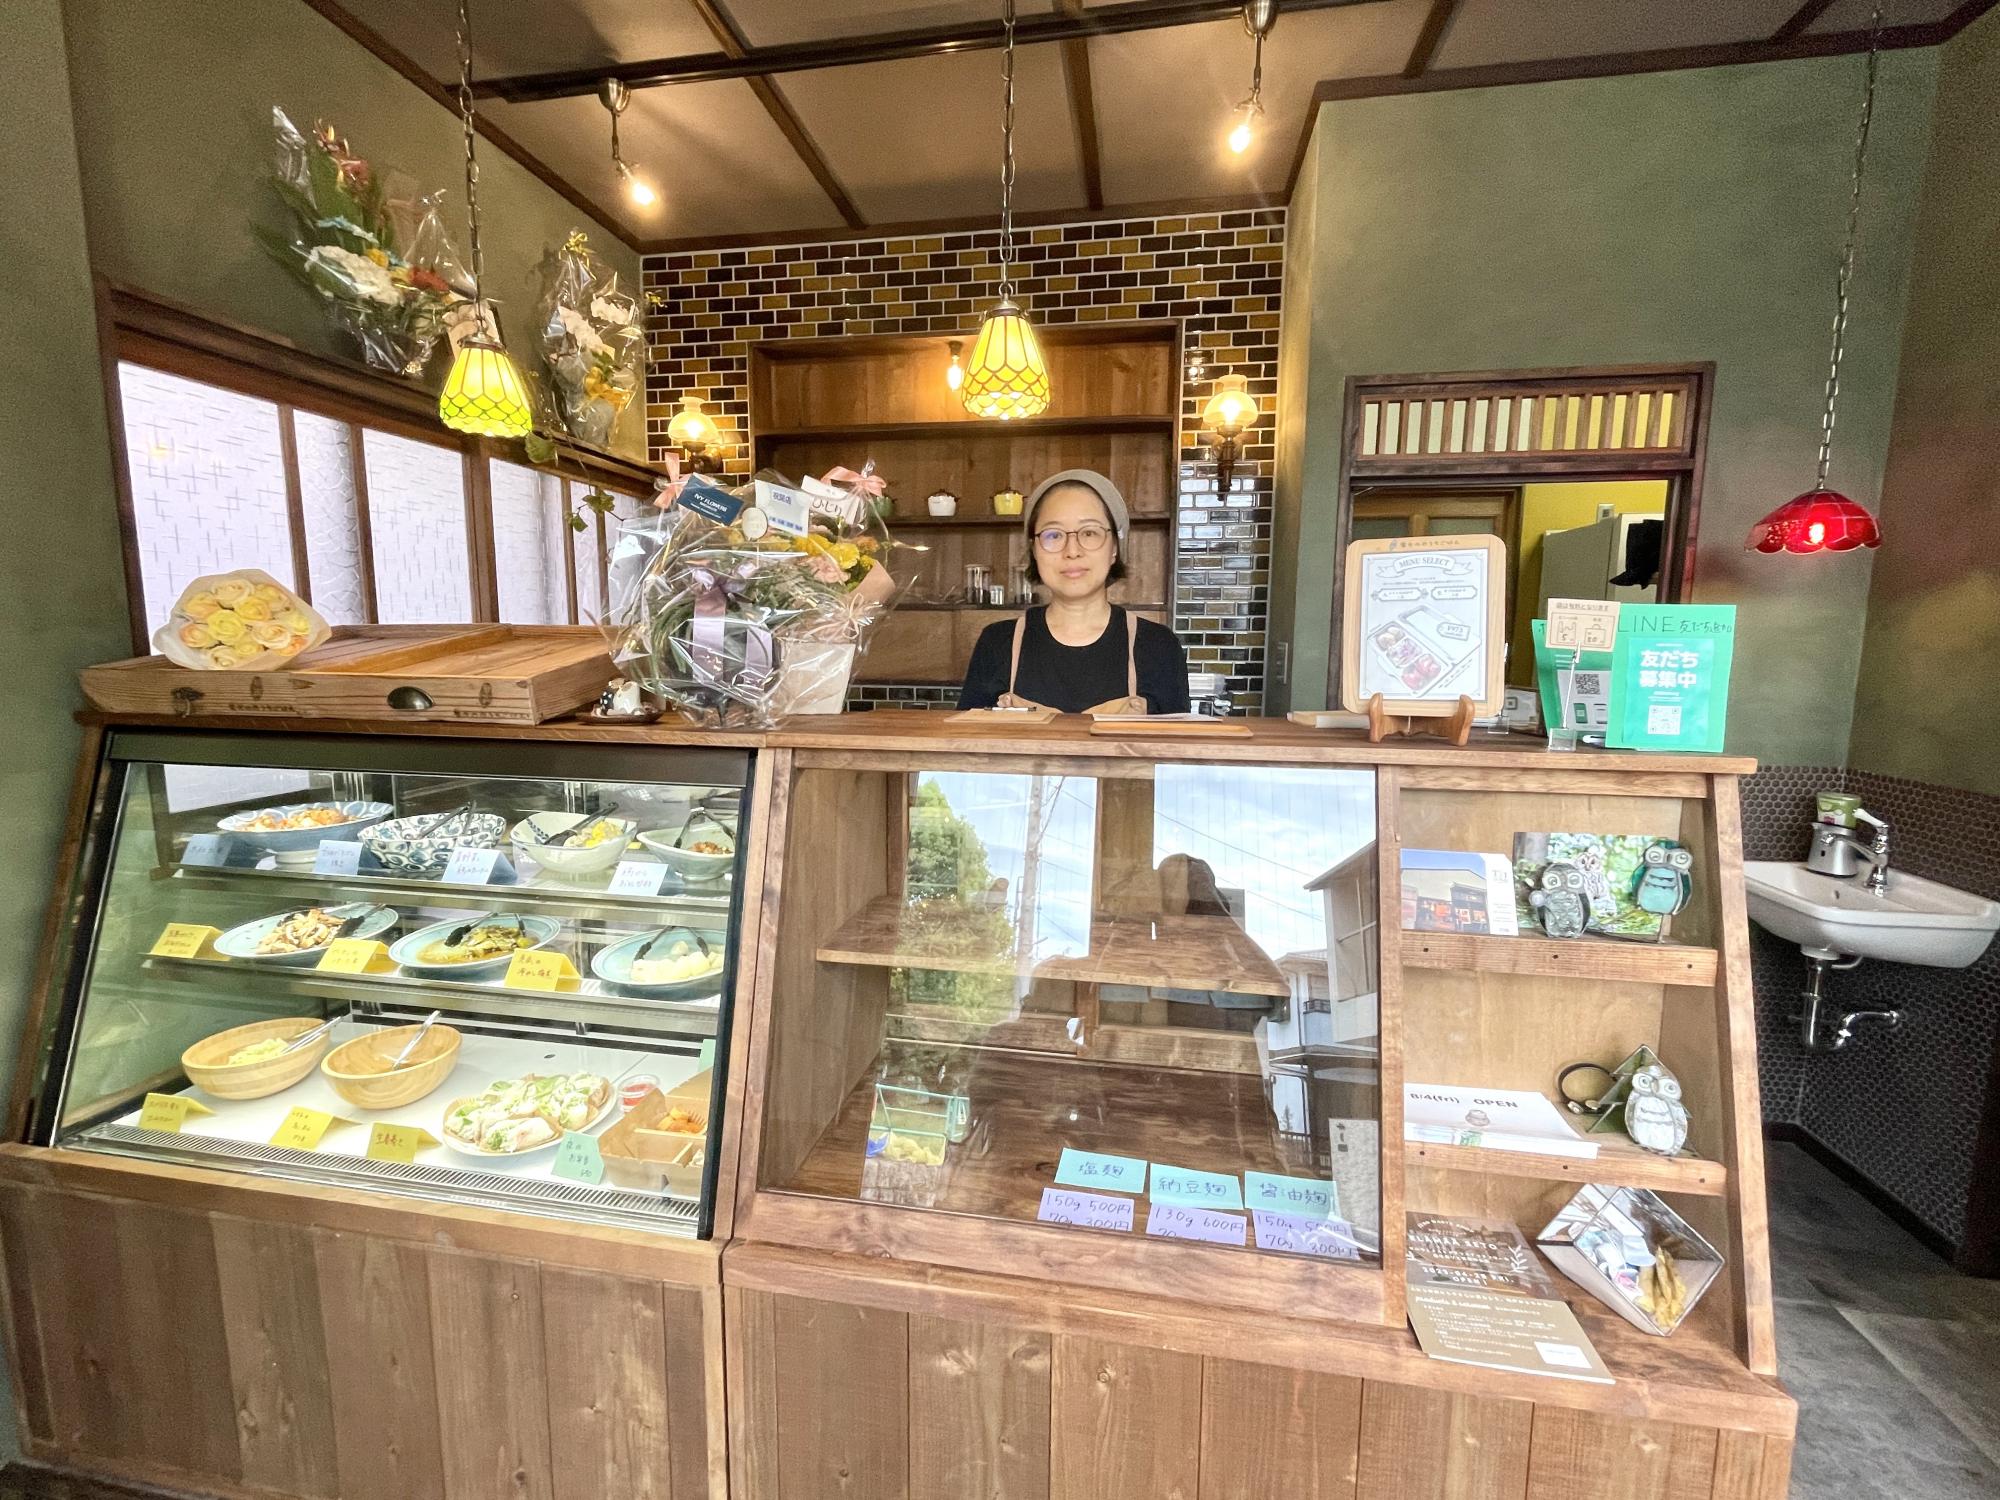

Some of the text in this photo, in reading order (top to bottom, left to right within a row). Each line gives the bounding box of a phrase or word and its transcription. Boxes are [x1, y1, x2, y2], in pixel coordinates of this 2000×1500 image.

[1398, 556, 1451, 567] MENU SELECT
[1617, 615, 1675, 633] LINE
[1640, 650, 1699, 668] 友だち
[1639, 670, 1697, 688] 募集中
[1473, 1098, 1519, 1109] OPEN
[1046, 1193, 1132, 1215] 150g 500円
[1155, 1206, 1245, 1233] 130g 600円
[1257, 1215, 1294, 1230] 150g
[1265, 1234, 1294, 1249] 70g
